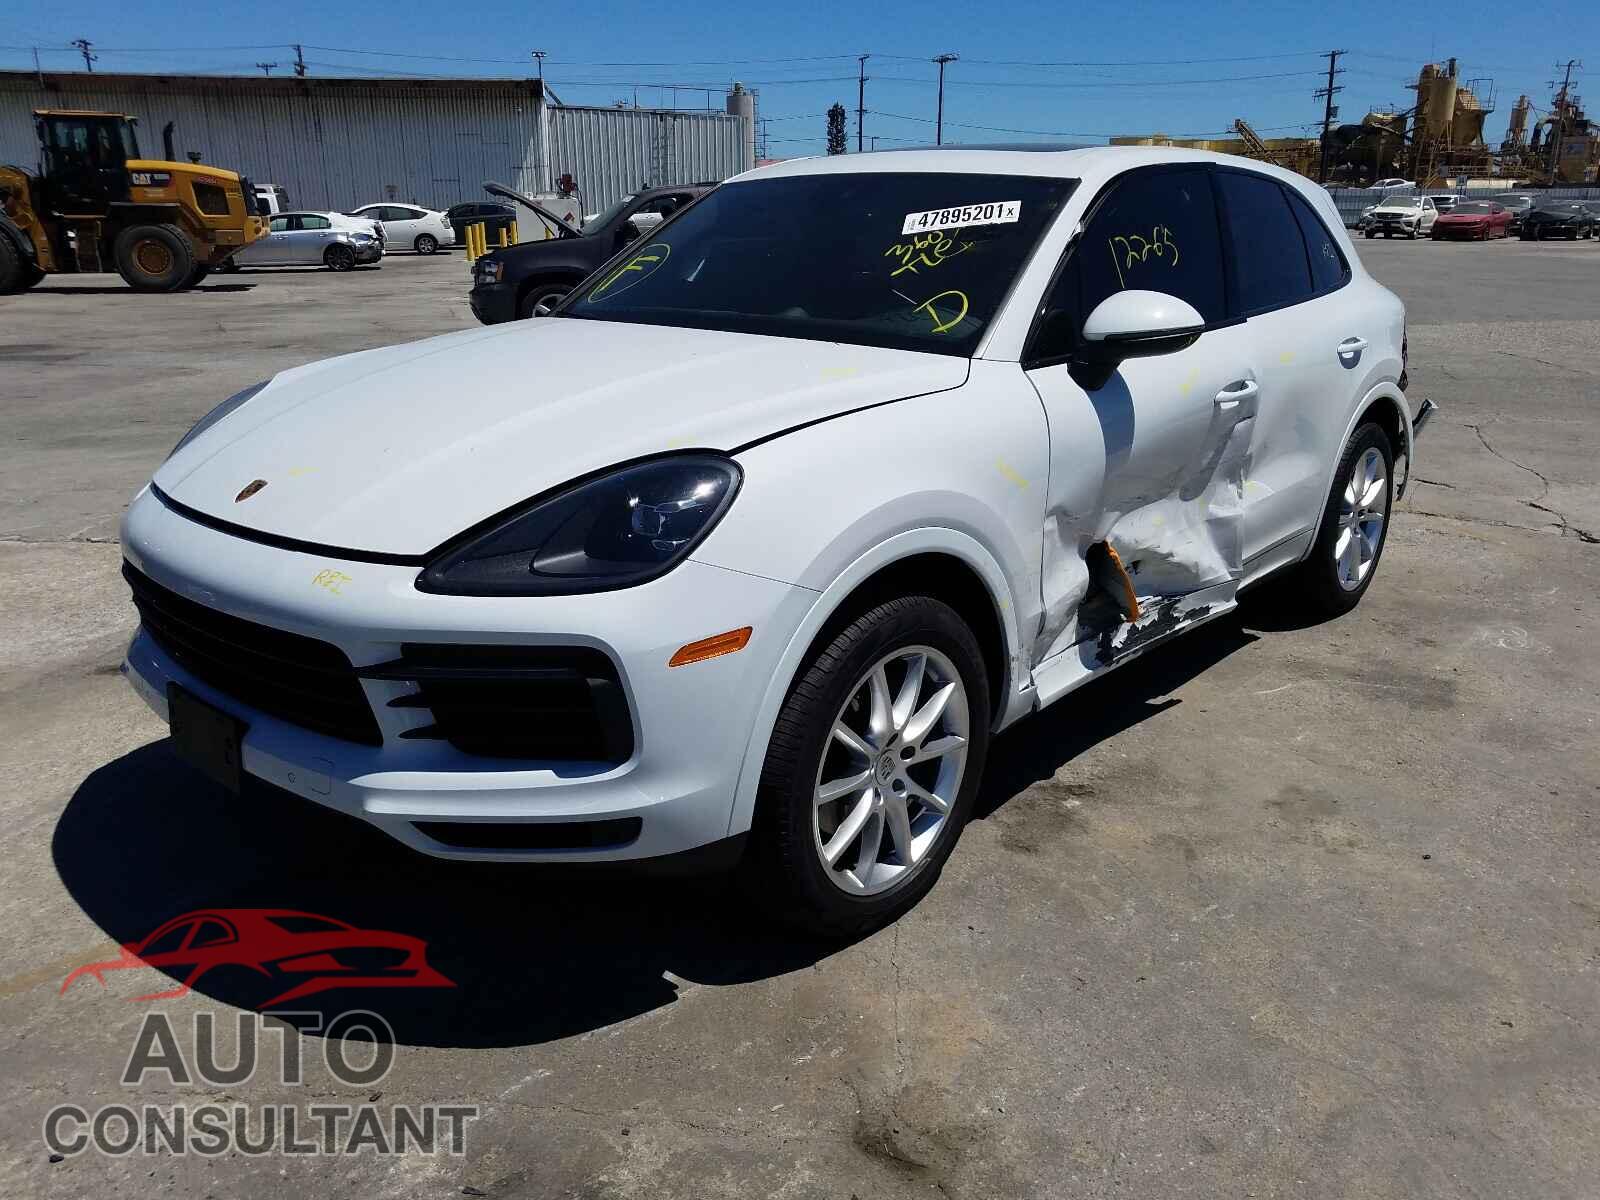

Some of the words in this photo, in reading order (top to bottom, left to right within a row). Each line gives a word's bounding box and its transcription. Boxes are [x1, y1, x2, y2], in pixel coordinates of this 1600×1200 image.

[132, 173, 151, 185] CAT
[918, 203, 1004, 228] 47895201
[598, 255, 661, 293] F
[912, 290, 969, 334] D
